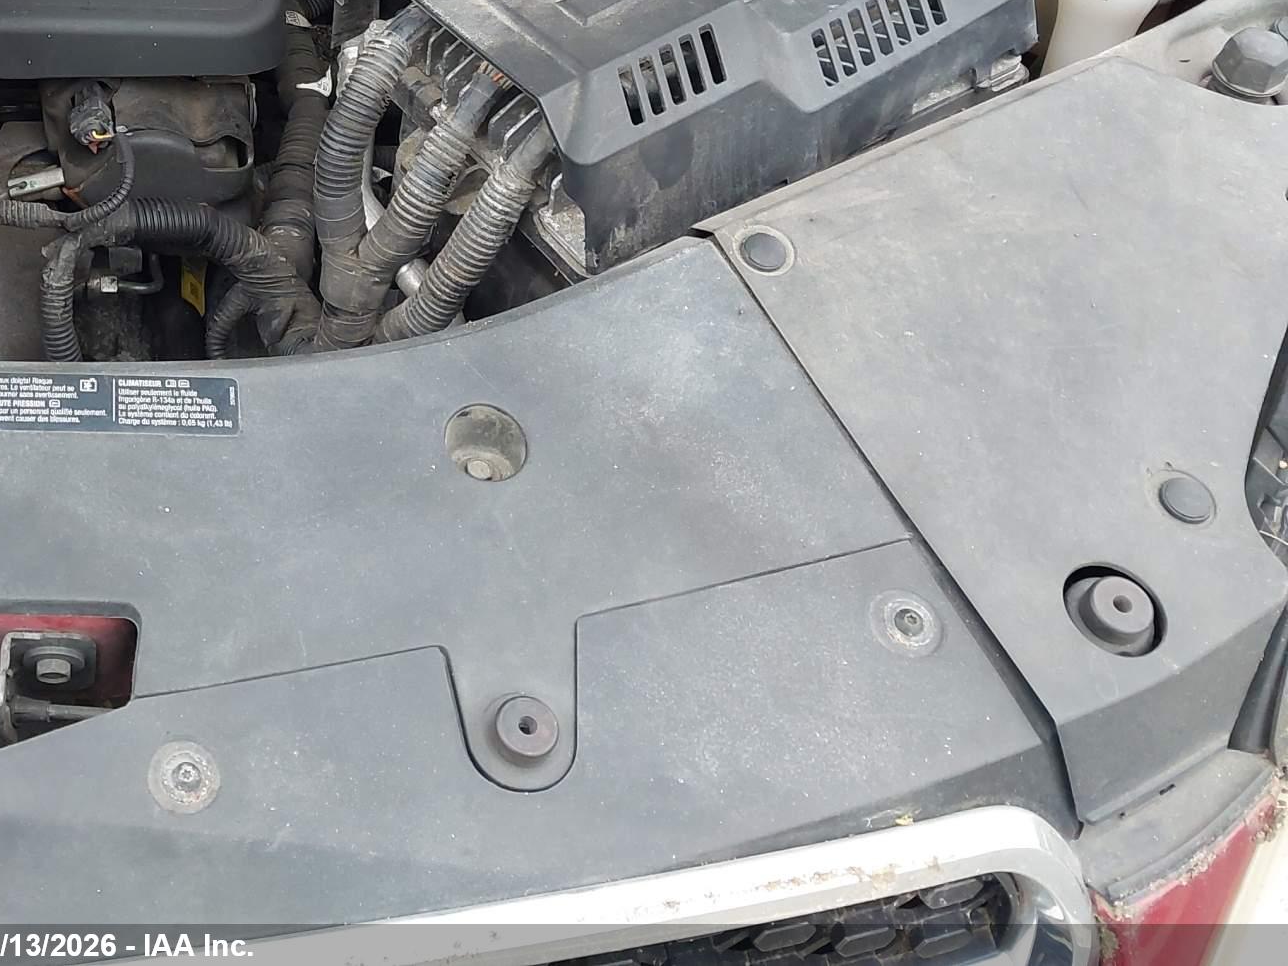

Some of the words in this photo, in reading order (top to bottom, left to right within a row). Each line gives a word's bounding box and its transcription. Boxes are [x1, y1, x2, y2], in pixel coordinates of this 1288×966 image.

[118, 379, 162, 387] CLIMATISEUR
[118, 388, 139, 396] Utiliser
[12, 399, 46, 407] PRESSION
[20, 408, 49, 416] personnel
[118, 418, 140, 426] Charge
